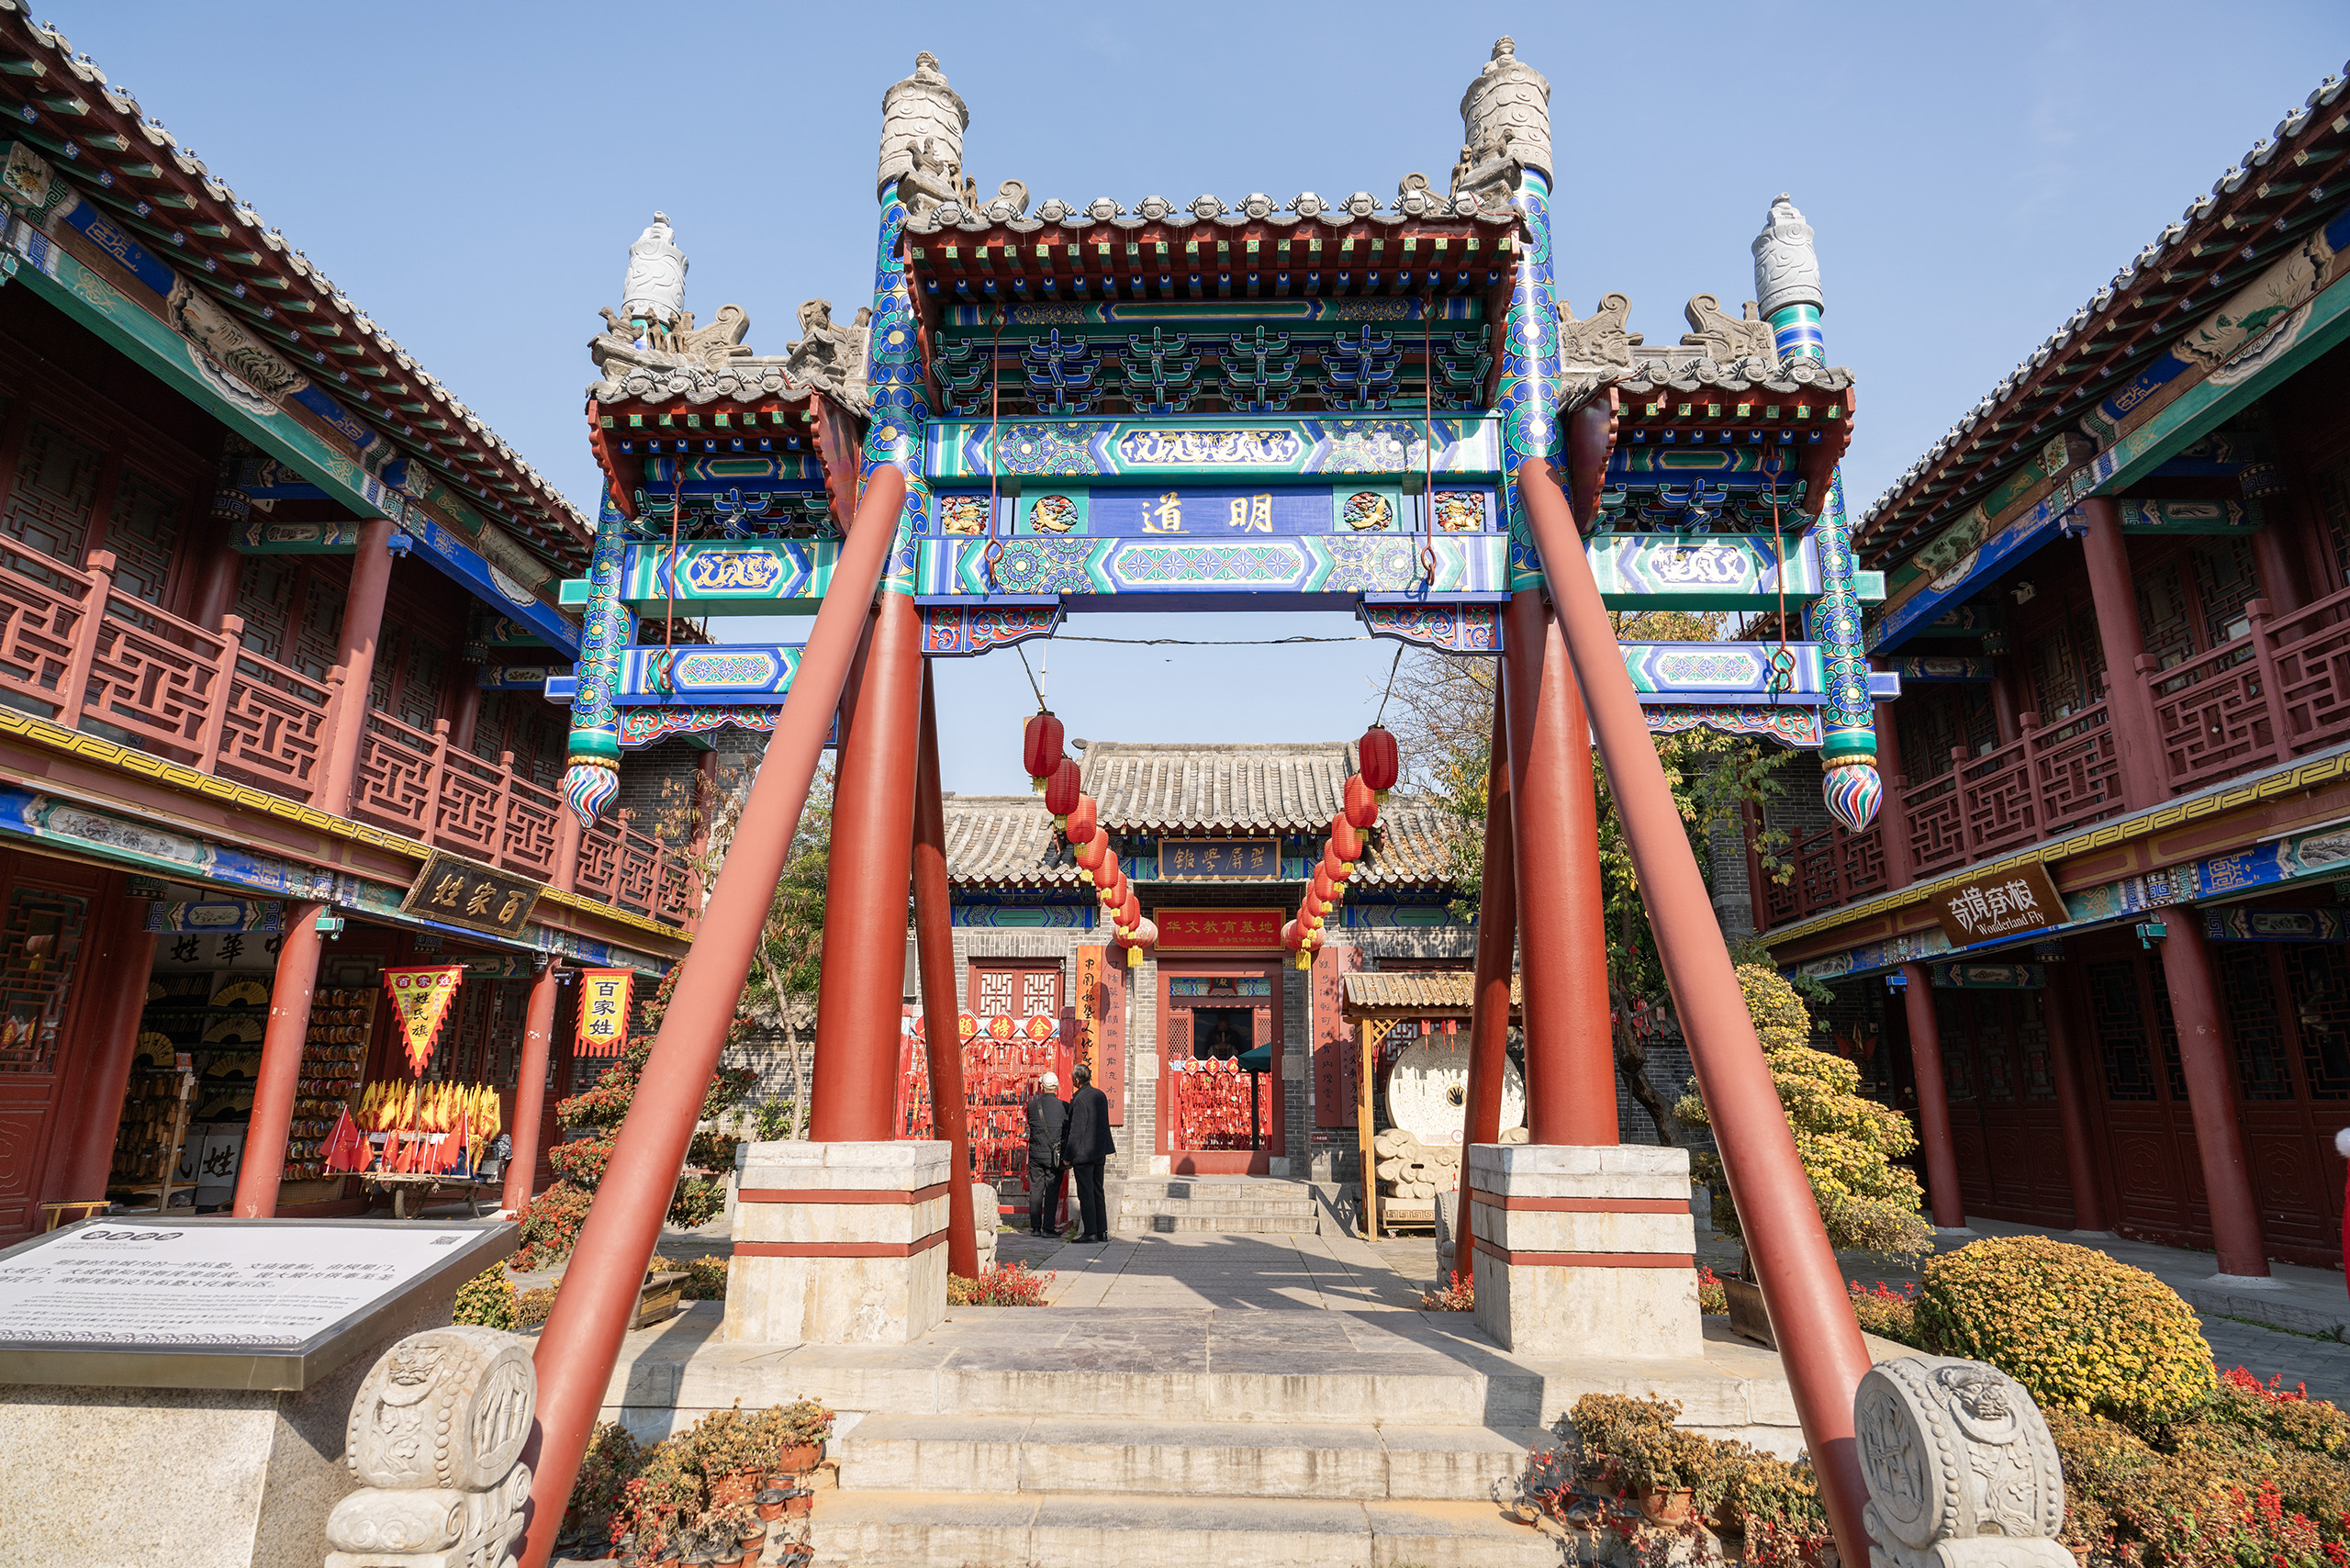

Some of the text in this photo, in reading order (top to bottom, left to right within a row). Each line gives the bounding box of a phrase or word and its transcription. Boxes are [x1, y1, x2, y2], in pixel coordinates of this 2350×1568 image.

[1141, 491, 1274, 534] 明道
[431, 873, 528, 924] 百家姓
[1947, 878, 2038, 935] 奇境穿梭
[1165, 920, 1275, 935] 华文教育基地
[1976, 911, 2045, 936] Wonderland Fly
[397, 975, 452, 987] 百家姓
[411, 991, 431, 1037] 姓氏旗
[588, 980, 621, 1036] 百家姓
[919, 1017, 1050, 1038] 金榜题
